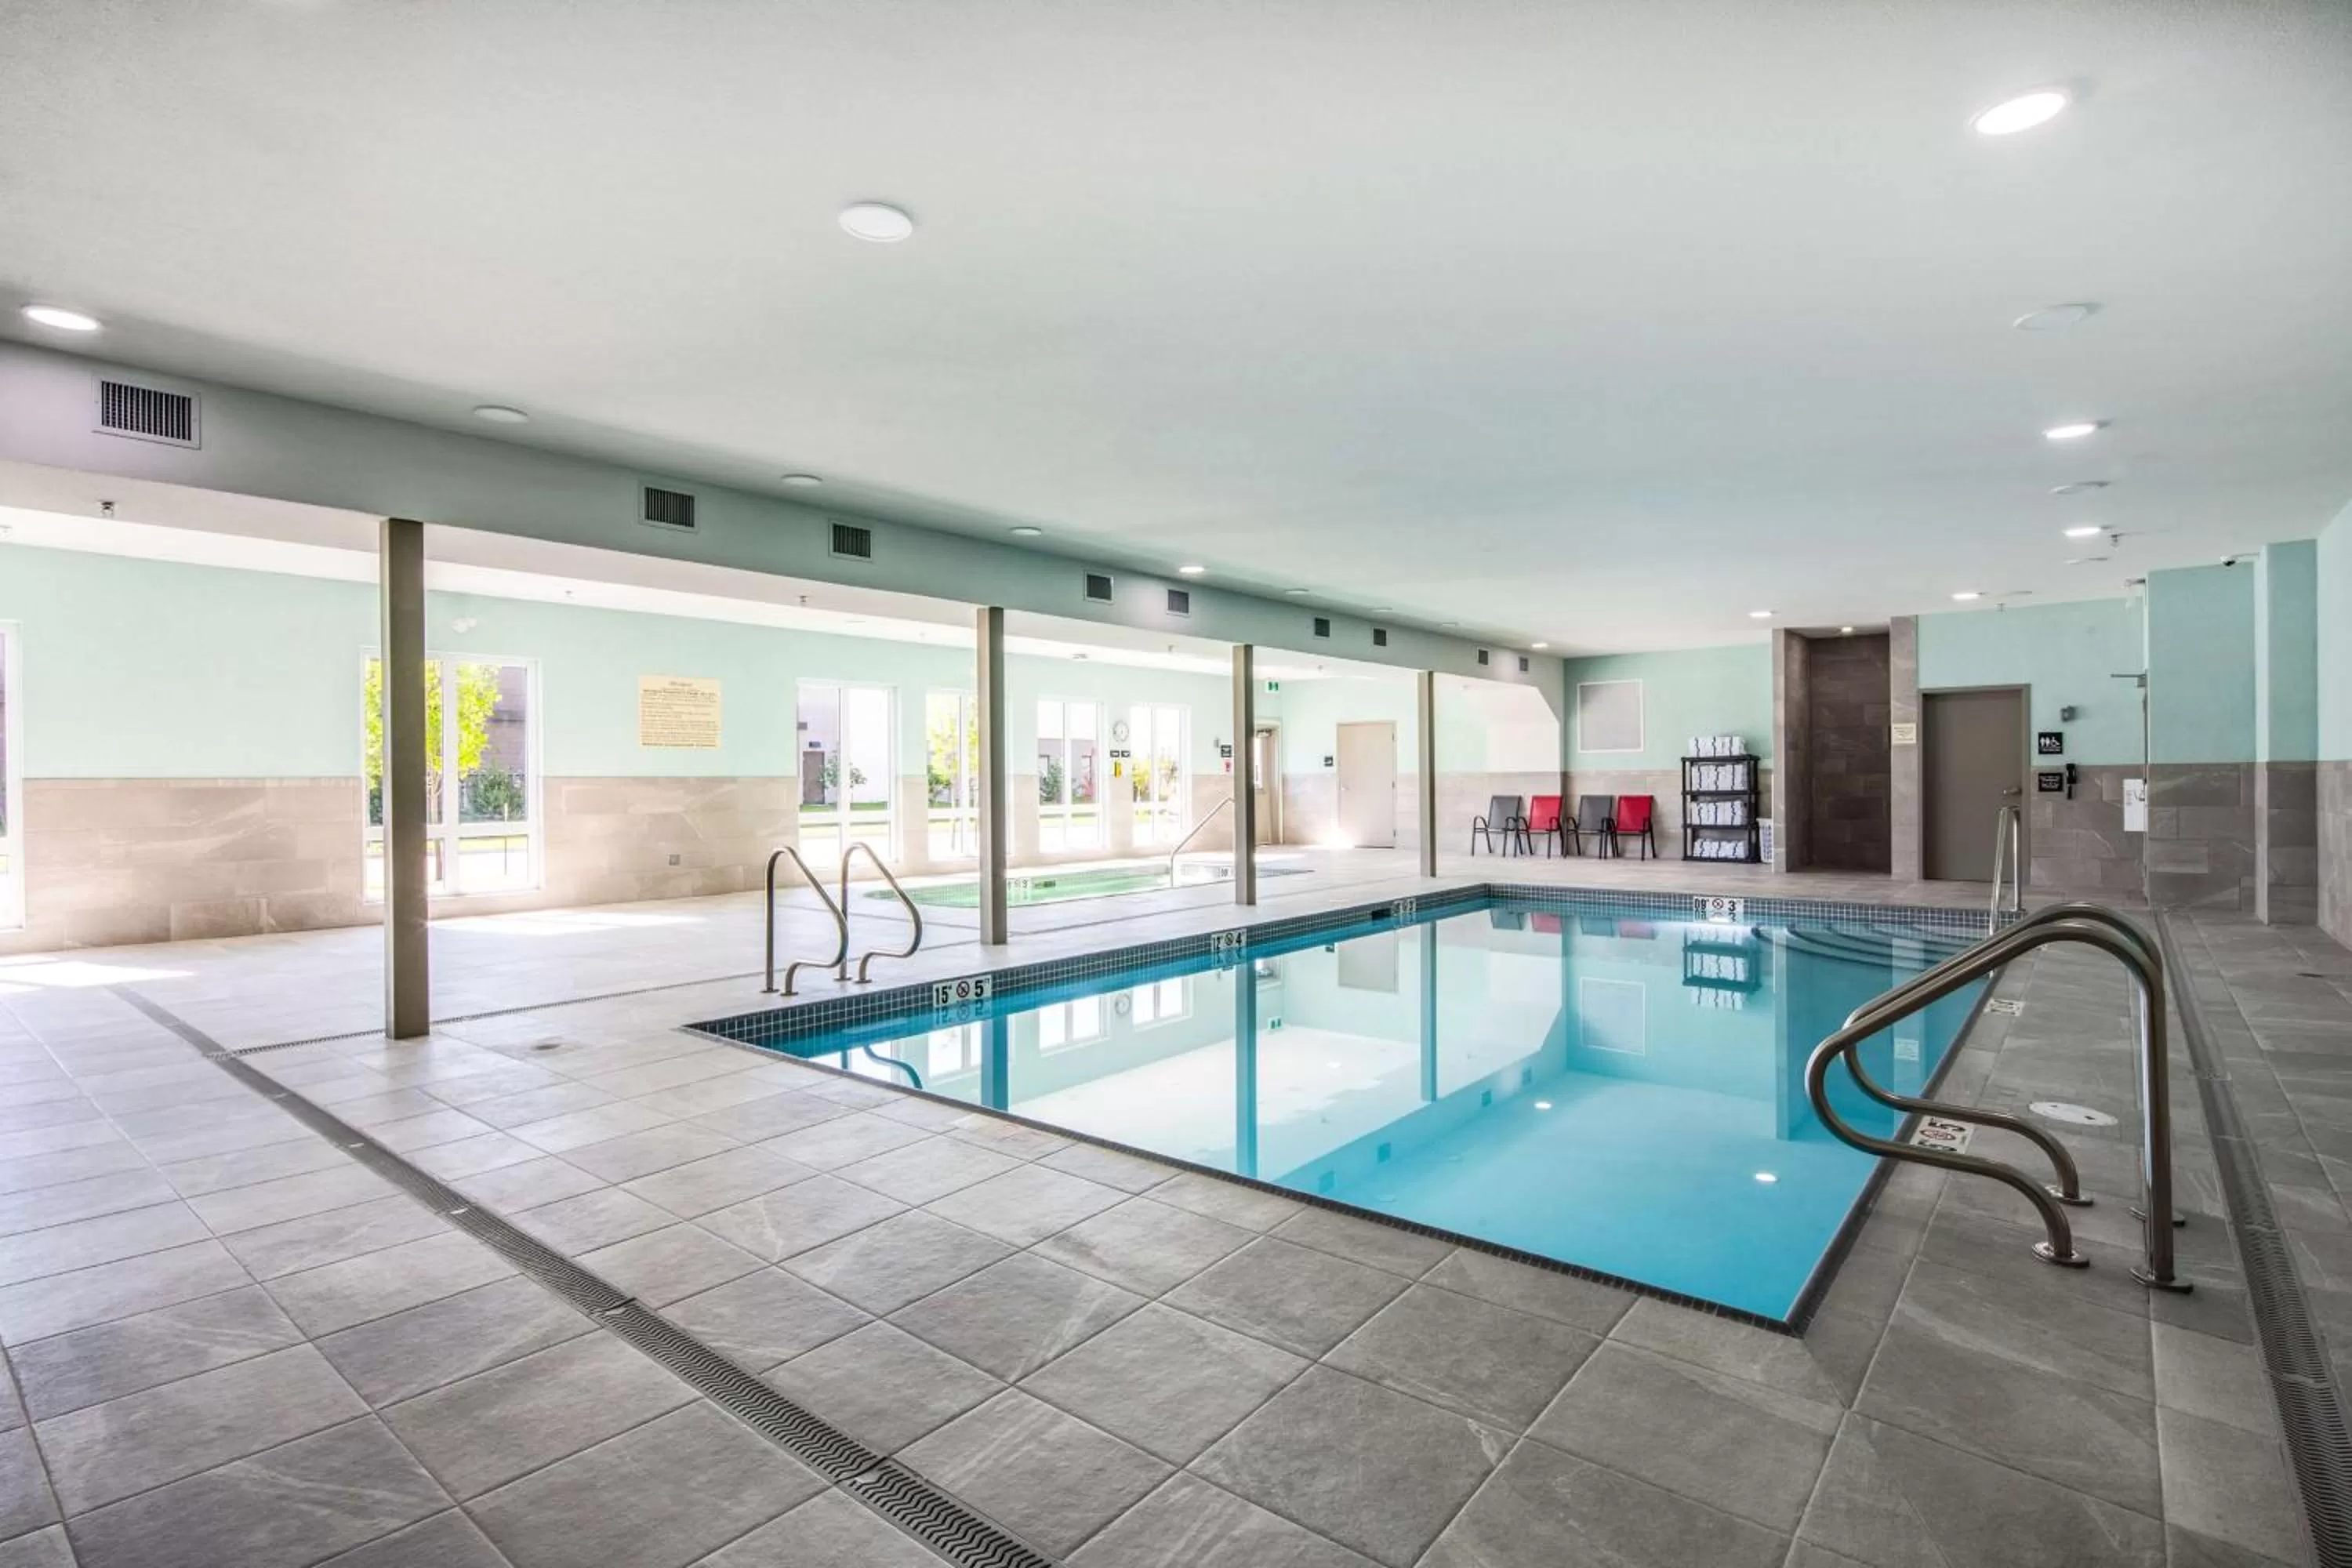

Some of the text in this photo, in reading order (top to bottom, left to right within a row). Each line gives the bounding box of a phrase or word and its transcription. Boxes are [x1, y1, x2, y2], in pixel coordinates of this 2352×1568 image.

[1727, 900, 1736, 911] 3
[1236, 932, 1243, 946] 4
[975, 979, 984, 998] 5
